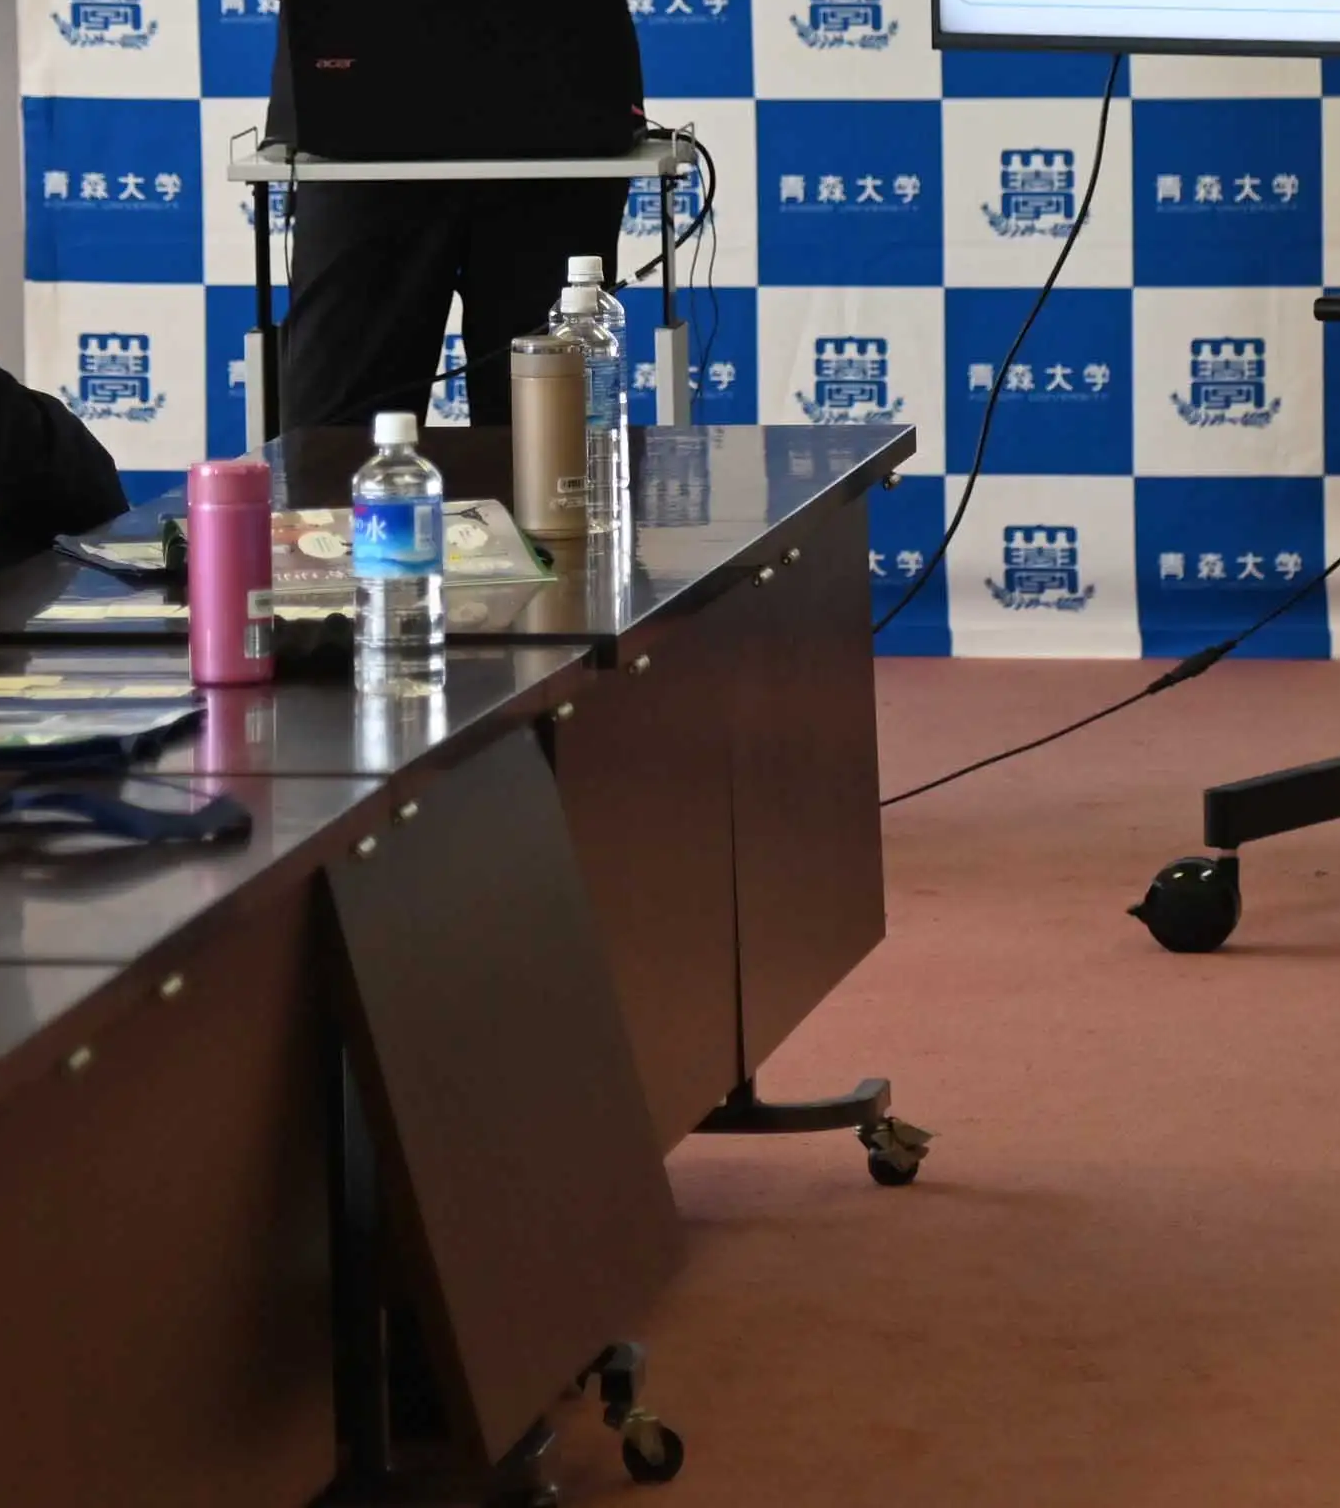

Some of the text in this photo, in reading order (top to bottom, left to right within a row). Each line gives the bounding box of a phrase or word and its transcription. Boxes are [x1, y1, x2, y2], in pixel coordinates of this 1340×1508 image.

[315, 58, 358, 70] acer
[43, 170, 181, 201] 青森大学
[779, 174, 921, 204] 青森大学
[1156, 174, 1299, 202] 青森大学
[968, 363, 1110, 392] 青森大学
[1159, 552, 1302, 580] 青森大学
